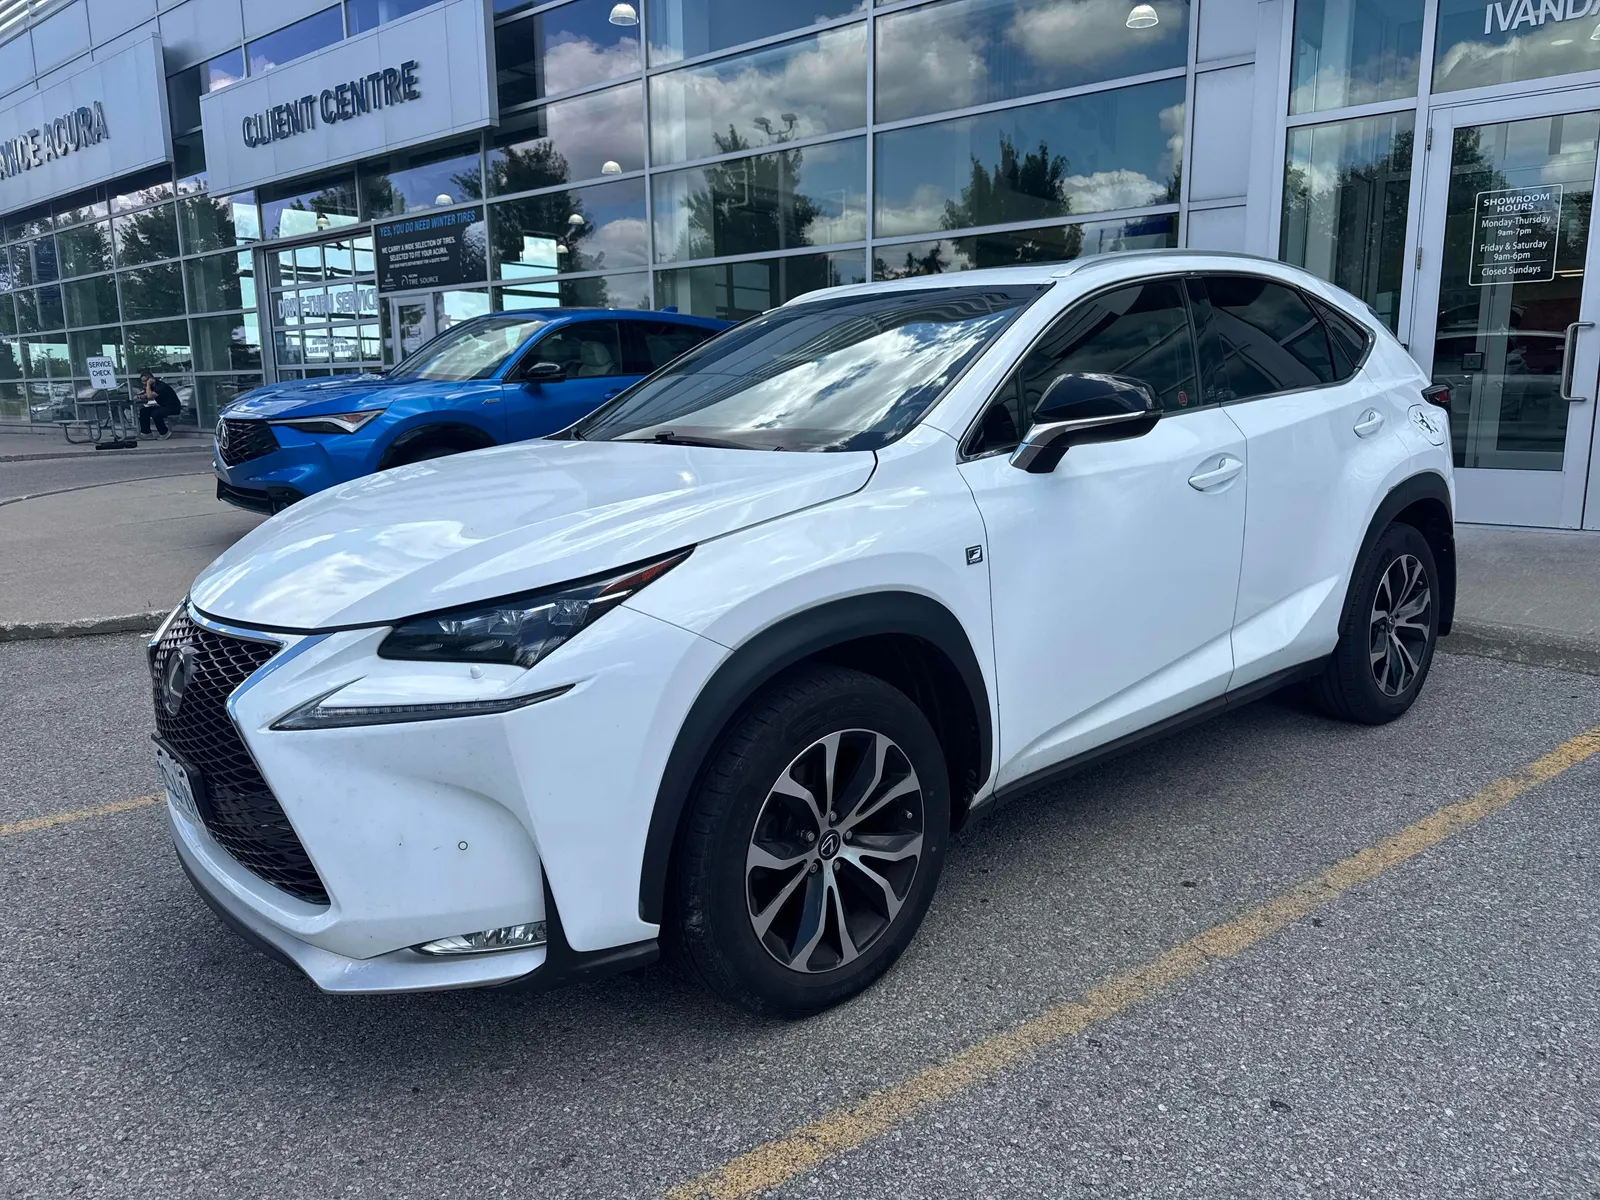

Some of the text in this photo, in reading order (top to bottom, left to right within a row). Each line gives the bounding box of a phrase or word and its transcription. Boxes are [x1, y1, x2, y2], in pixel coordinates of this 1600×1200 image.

[242, 59, 421, 148] CLIENT CENTRE
[43, 100, 110, 162] ACURA
[1483, 193, 1550, 207] SHOWROOM
[1496, 203, 1534, 213] HOURS
[380, 210, 476, 237] YES, YOU DO NEED WINTER TIRES
[1481, 214, 1551, 228] Monday-Thursday
[1497, 228, 1532, 237] 9am-7pm
[381, 246, 388, 254] WE
[388, 243, 400, 253] CARRY
[405, 241, 414, 250] WIDE
[414, 238, 436, 249] SELECTION
[437, 237, 442, 246] OF
[1480, 240, 1548, 253] Friday & Saturday
[389, 252, 408, 262] SELECTED
[409, 251, 415, 259] TO
[421, 248, 432, 257] YOUR
[1493, 252, 1531, 261] 9am-6pm
[1481, 265, 1541, 276] Closed Sundays
[419, 276, 439, 284] SOURCE
[88, 360, 112, 368] SERVICE
